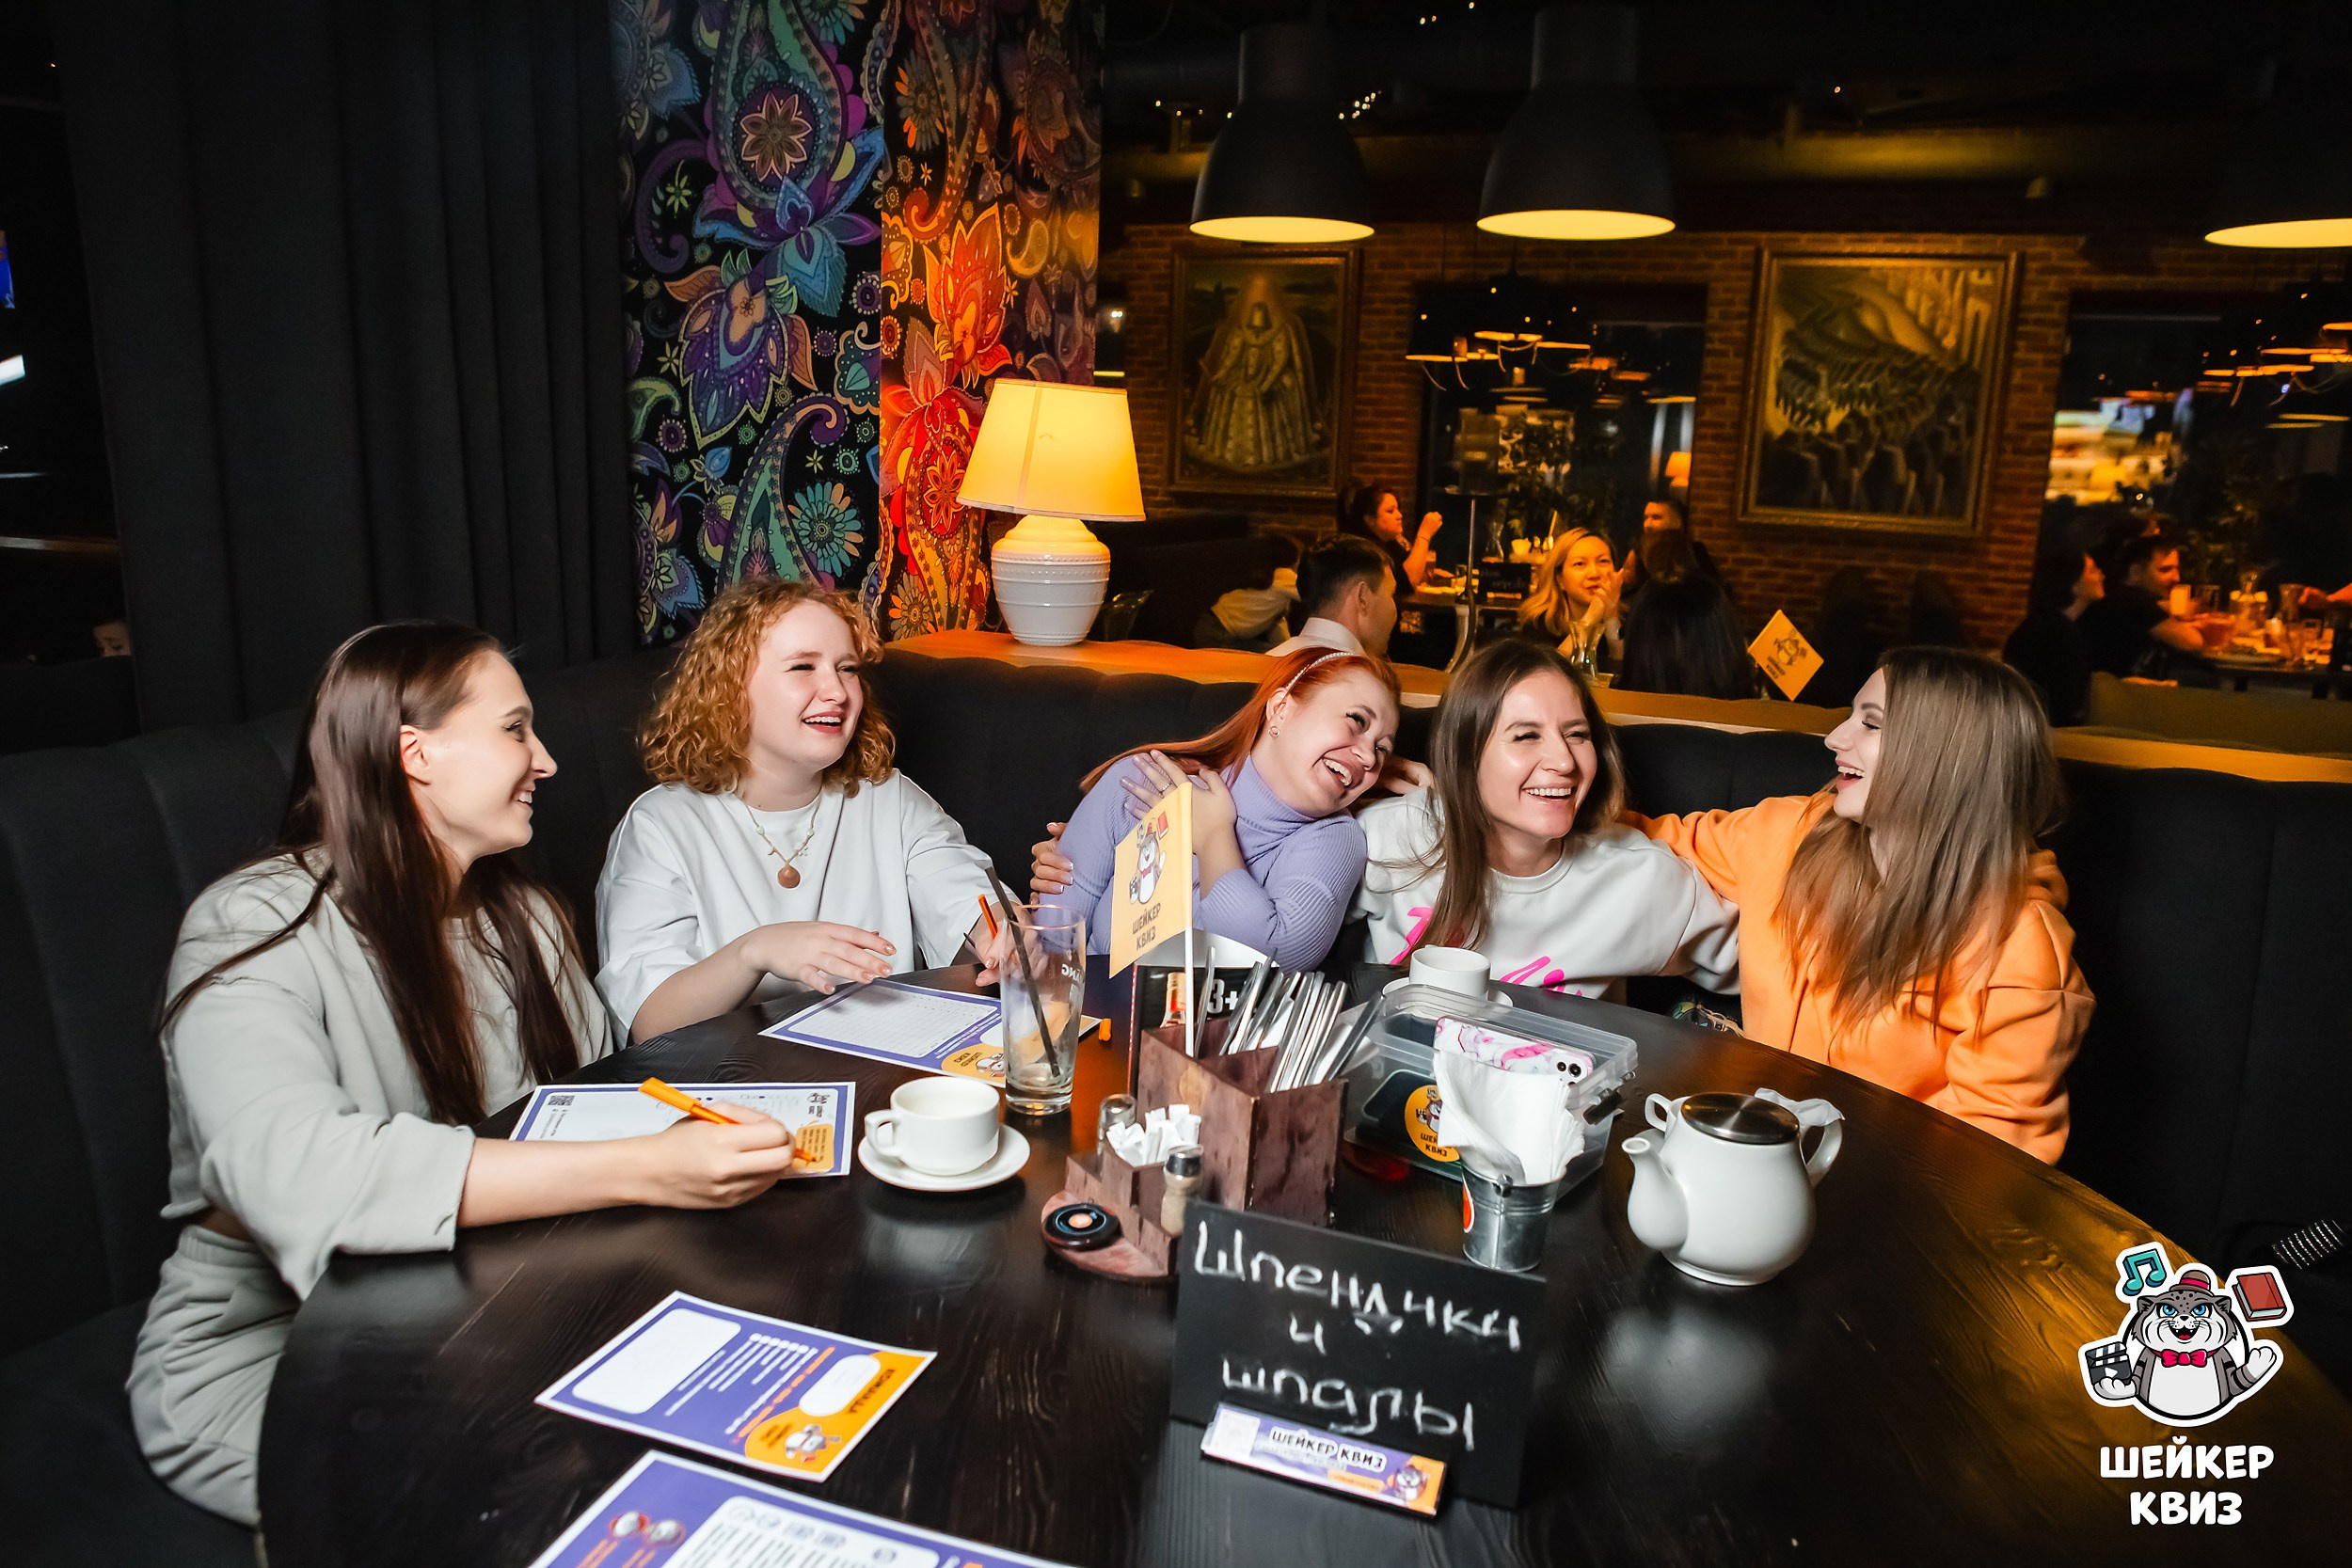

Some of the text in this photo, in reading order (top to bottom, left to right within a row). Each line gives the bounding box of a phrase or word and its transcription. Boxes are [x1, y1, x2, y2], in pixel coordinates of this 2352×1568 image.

[1132, 902, 1162, 935] ШЕЙКЕР
[1136, 926, 1156, 951] КВИЗ
[1425, 1144, 1448, 1157] КВИЗ
[1271, 1429, 1336, 1456] ШЕЙКЕР
[1340, 1447, 1385, 1469] КВИЗ
